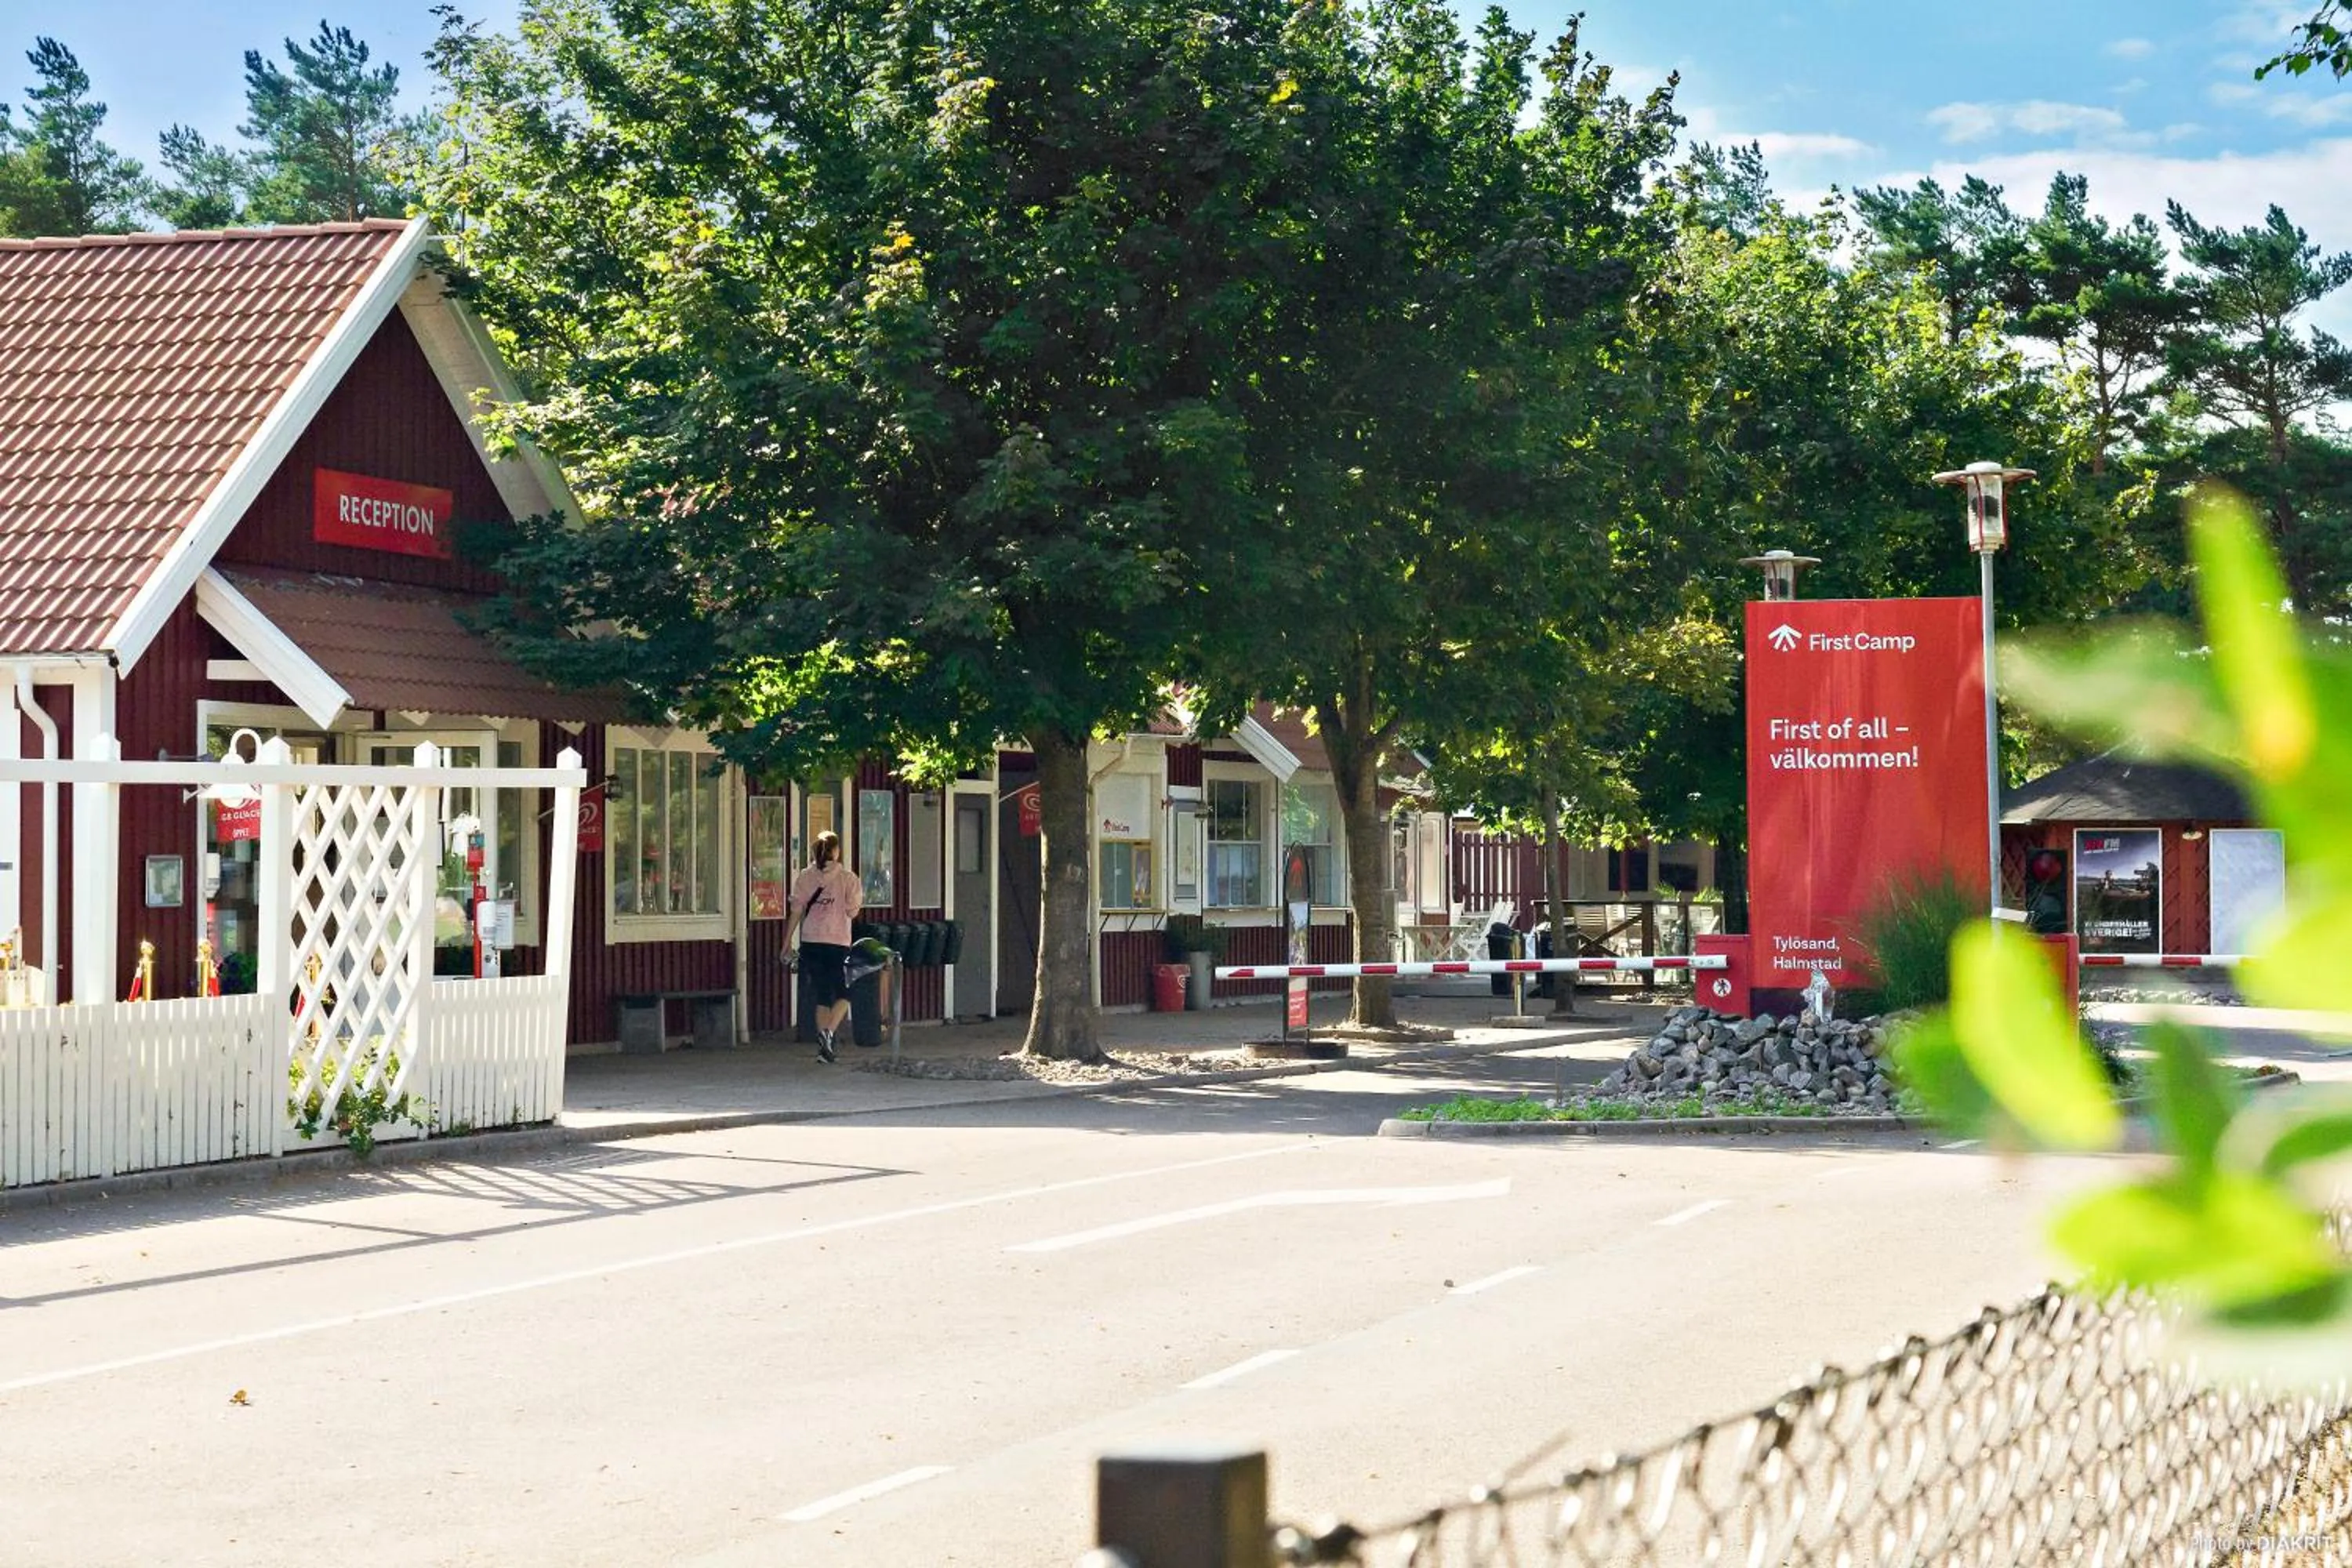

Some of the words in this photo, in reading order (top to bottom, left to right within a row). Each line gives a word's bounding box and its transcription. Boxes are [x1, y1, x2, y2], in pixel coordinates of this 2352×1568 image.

[339, 493, 434, 536] RECEPTION
[1809, 633, 1852, 651] First
[1854, 632, 1916, 653] Camp
[1769, 719, 1822, 740] First
[1827, 717, 1853, 739] of
[1857, 717, 1889, 739] all
[1769, 746, 1919, 769] välkommen!
[1773, 935, 1840, 953] Tylösand,
[1773, 956, 1842, 971] Halmstad
